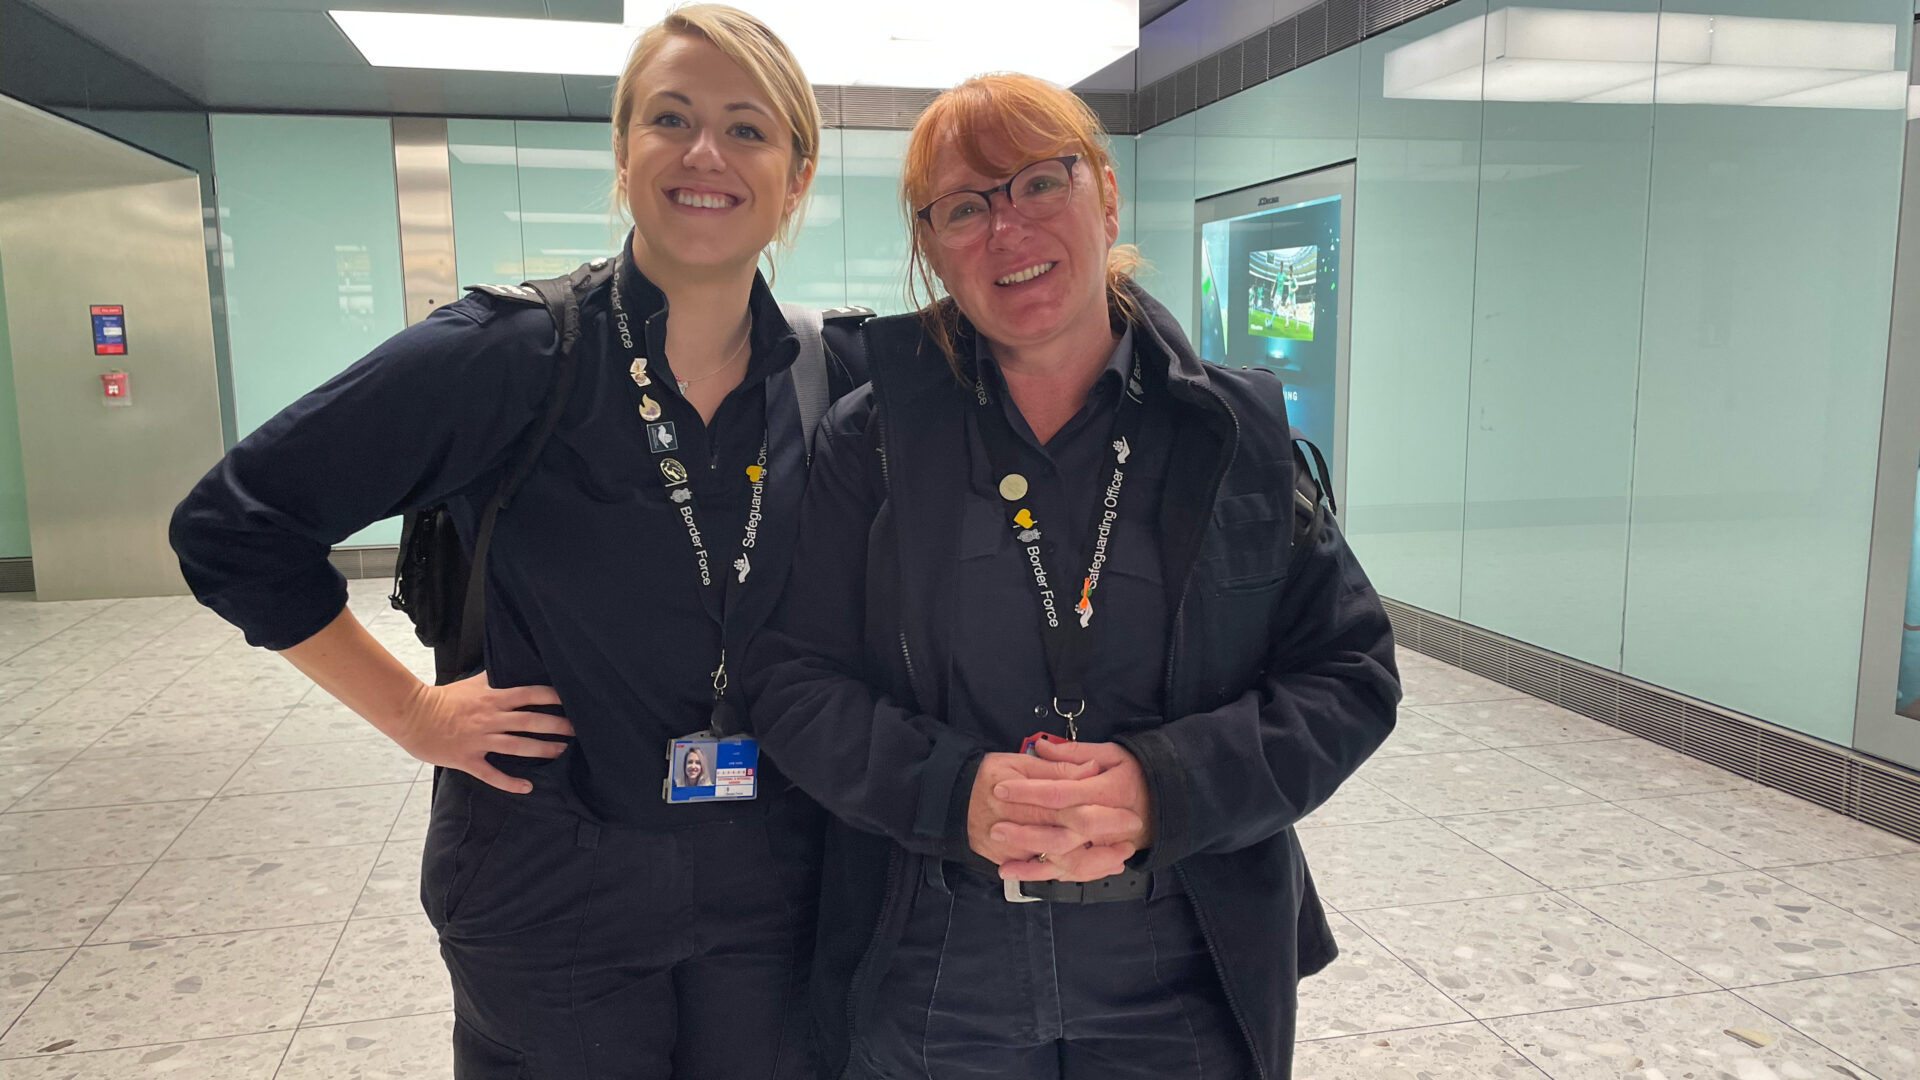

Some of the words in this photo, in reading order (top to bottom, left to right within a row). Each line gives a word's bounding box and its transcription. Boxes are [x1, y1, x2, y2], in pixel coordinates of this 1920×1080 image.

[616, 313, 633, 349] Force
[1283, 391, 1298, 401] ING
[680, 505, 703, 548] Border
[696, 549, 711, 586] Force
[742, 468, 767, 548] Safeguarding
[1088, 509, 1117, 590] Safeguarding
[1104, 468, 1125, 508] Officer
[1026, 545, 1048, 590] Border
[1040, 589, 1059, 628] Force
